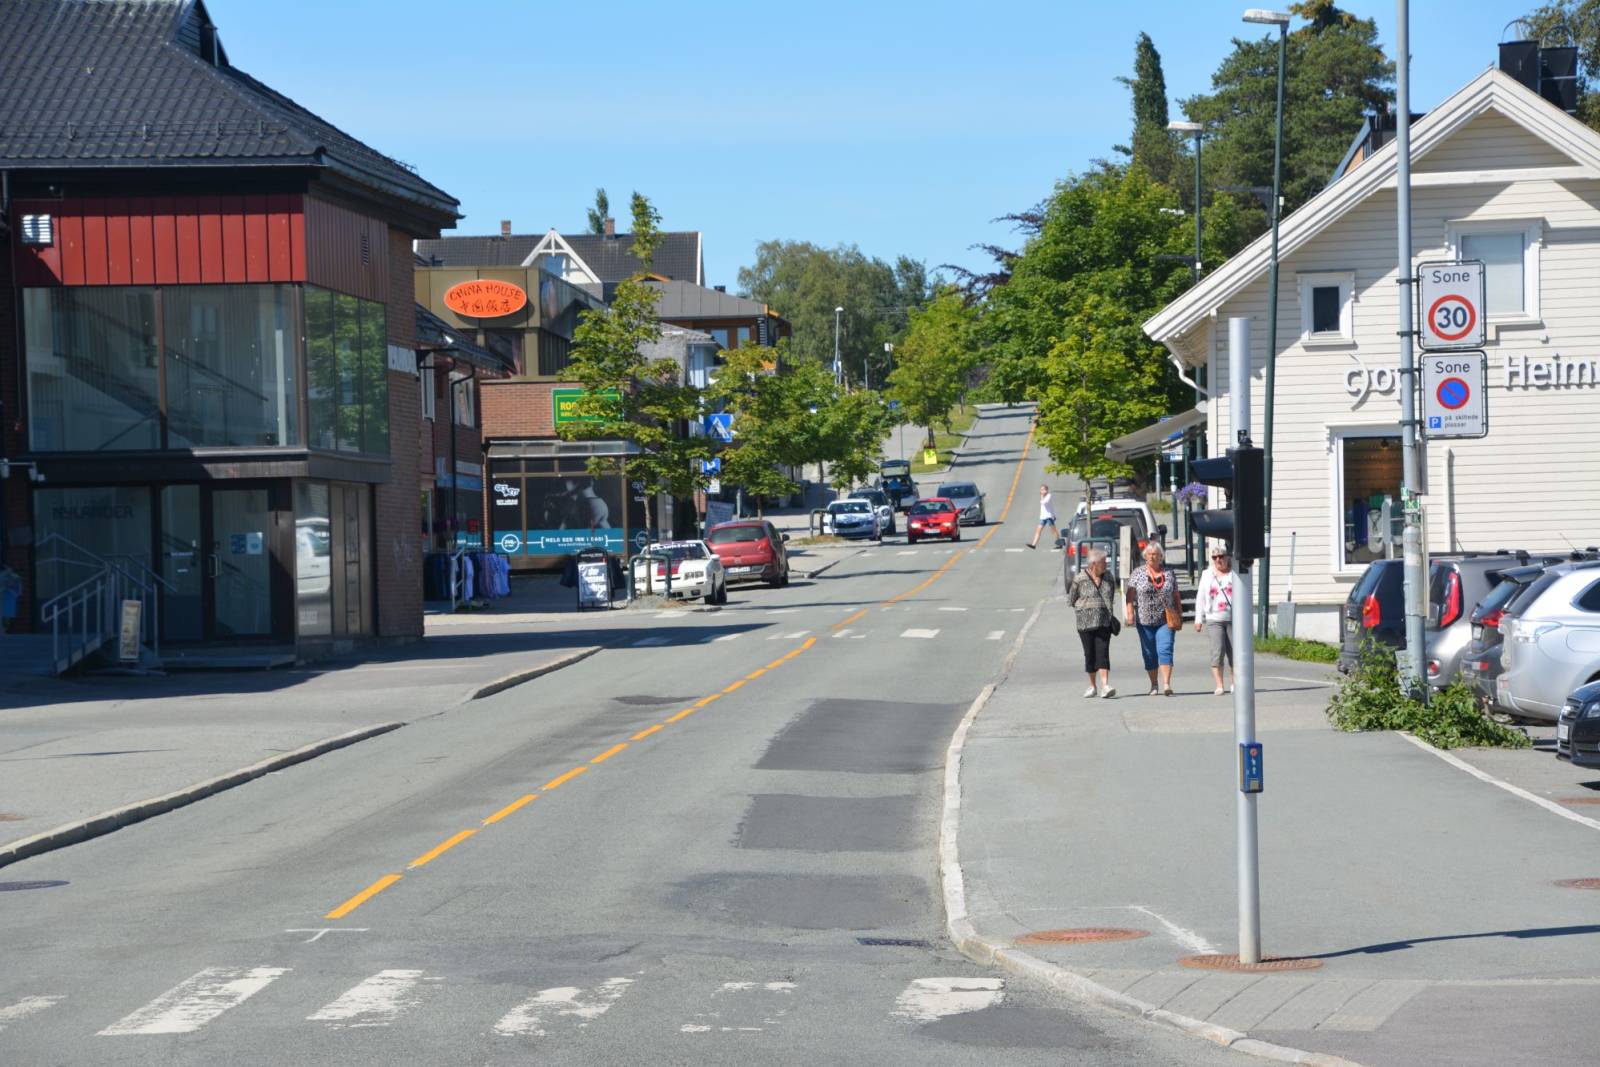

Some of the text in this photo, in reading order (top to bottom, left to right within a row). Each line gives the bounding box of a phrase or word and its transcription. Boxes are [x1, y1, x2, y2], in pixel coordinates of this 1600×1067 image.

[1432, 270, 1471, 284] Sone
[449, 283, 521, 301] CHINA HOUSE
[1436, 306, 1467, 329] 30
[1435, 361, 1471, 374] Sone
[1503, 353, 1600, 386] Heim
